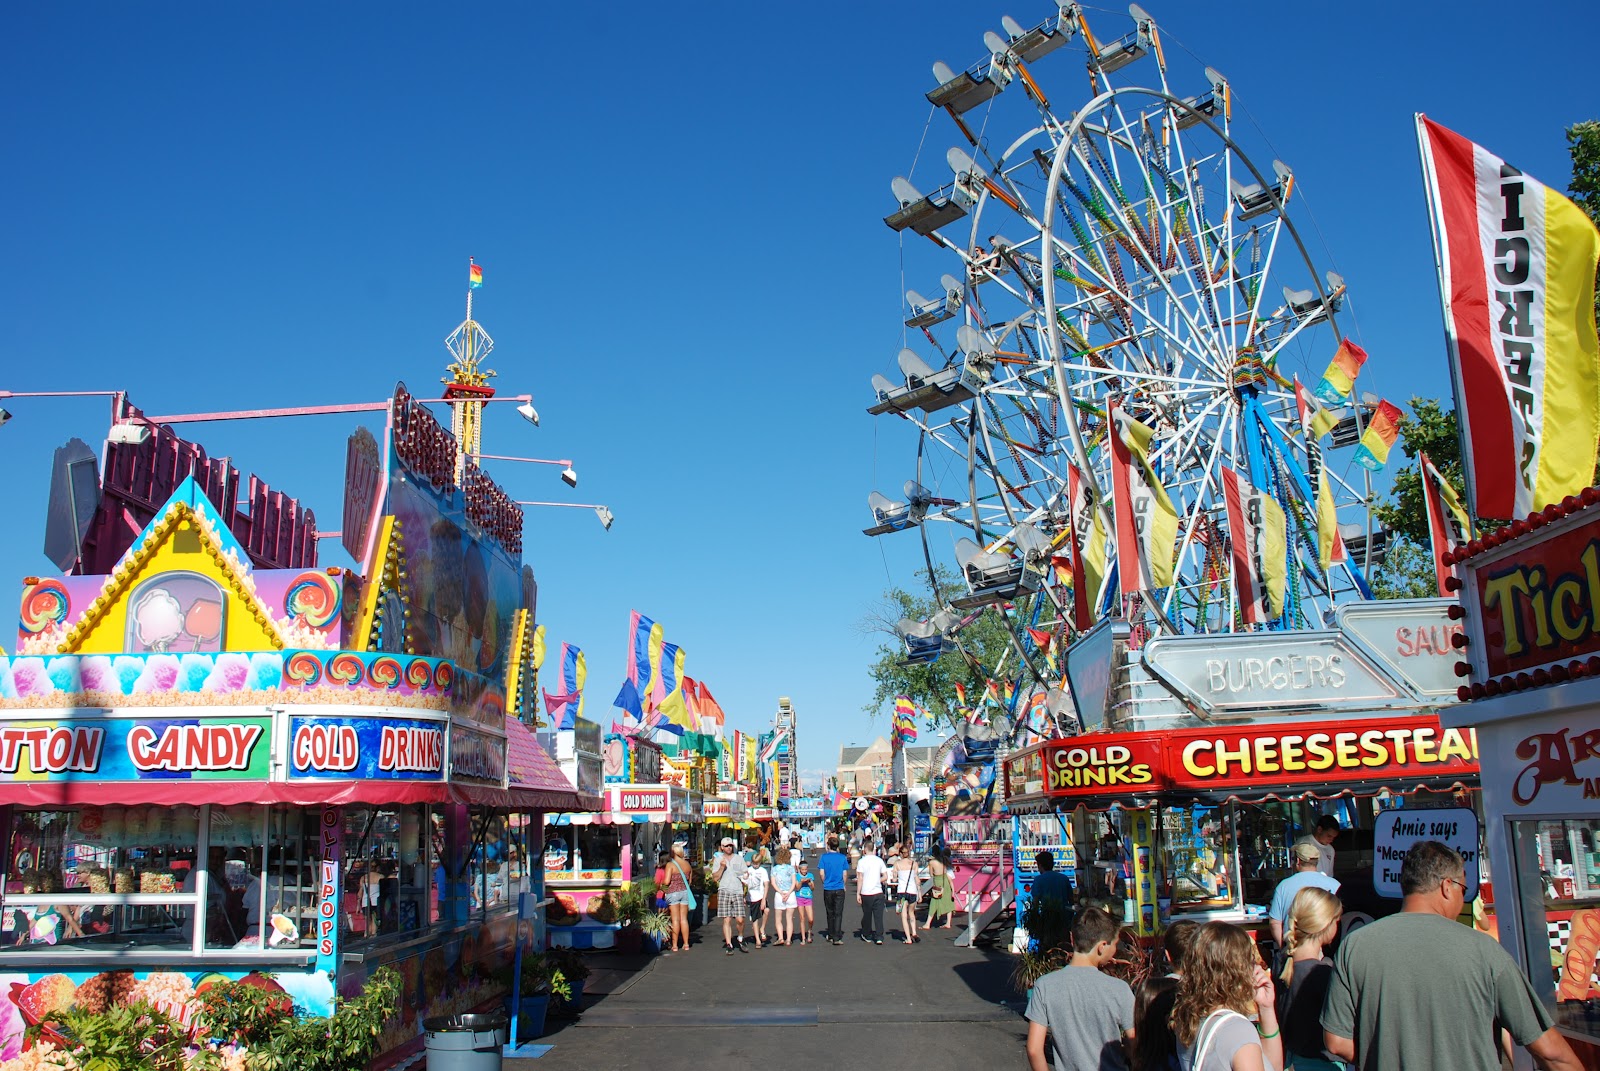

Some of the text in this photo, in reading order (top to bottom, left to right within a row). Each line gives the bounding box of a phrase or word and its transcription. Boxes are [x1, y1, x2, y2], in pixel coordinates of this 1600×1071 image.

[1076, 486, 1093, 552] SAUS
[1206, 654, 1346, 694] BURGERS
[0, 724, 262, 772] TTON CANDY
[292, 725, 444, 771] COLD DRINKS
[1054, 746, 1131, 768] COLD
[1050, 764, 1153, 787] DRINKS
[623, 794, 665, 809] COLD DRINKS
[704, 804, 716, 815] OLD
[1392, 816, 1457, 841] Arnie says
